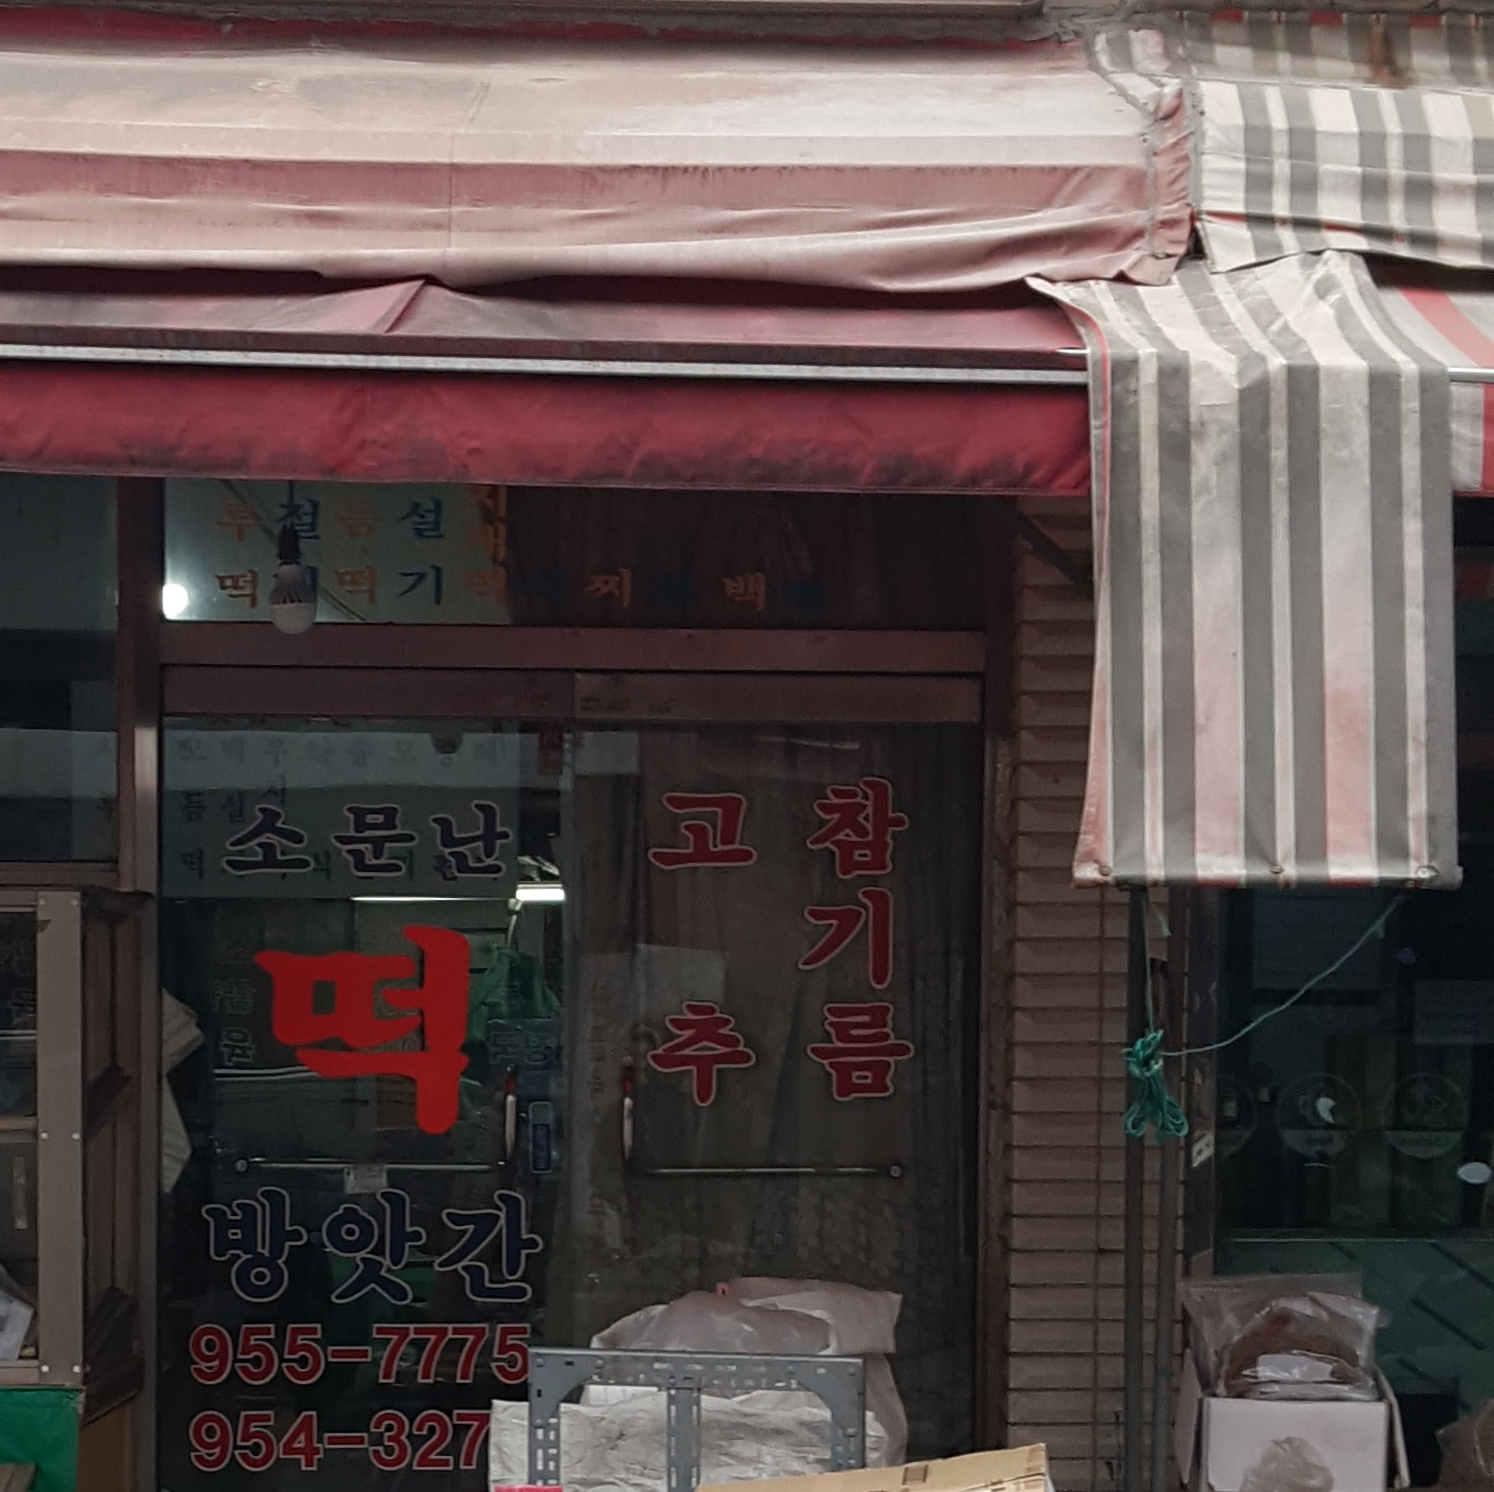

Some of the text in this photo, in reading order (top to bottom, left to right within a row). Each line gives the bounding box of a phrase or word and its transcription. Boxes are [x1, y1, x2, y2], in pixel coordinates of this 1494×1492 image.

[221, 799, 511, 877] 소문난
[254, 924, 470, 1135] 떡
[202, 1187, 543, 1302] 방앗간
[188, 1323, 529, 1386] 955-7775
[188, 1409, 491, 1472] 954-327
